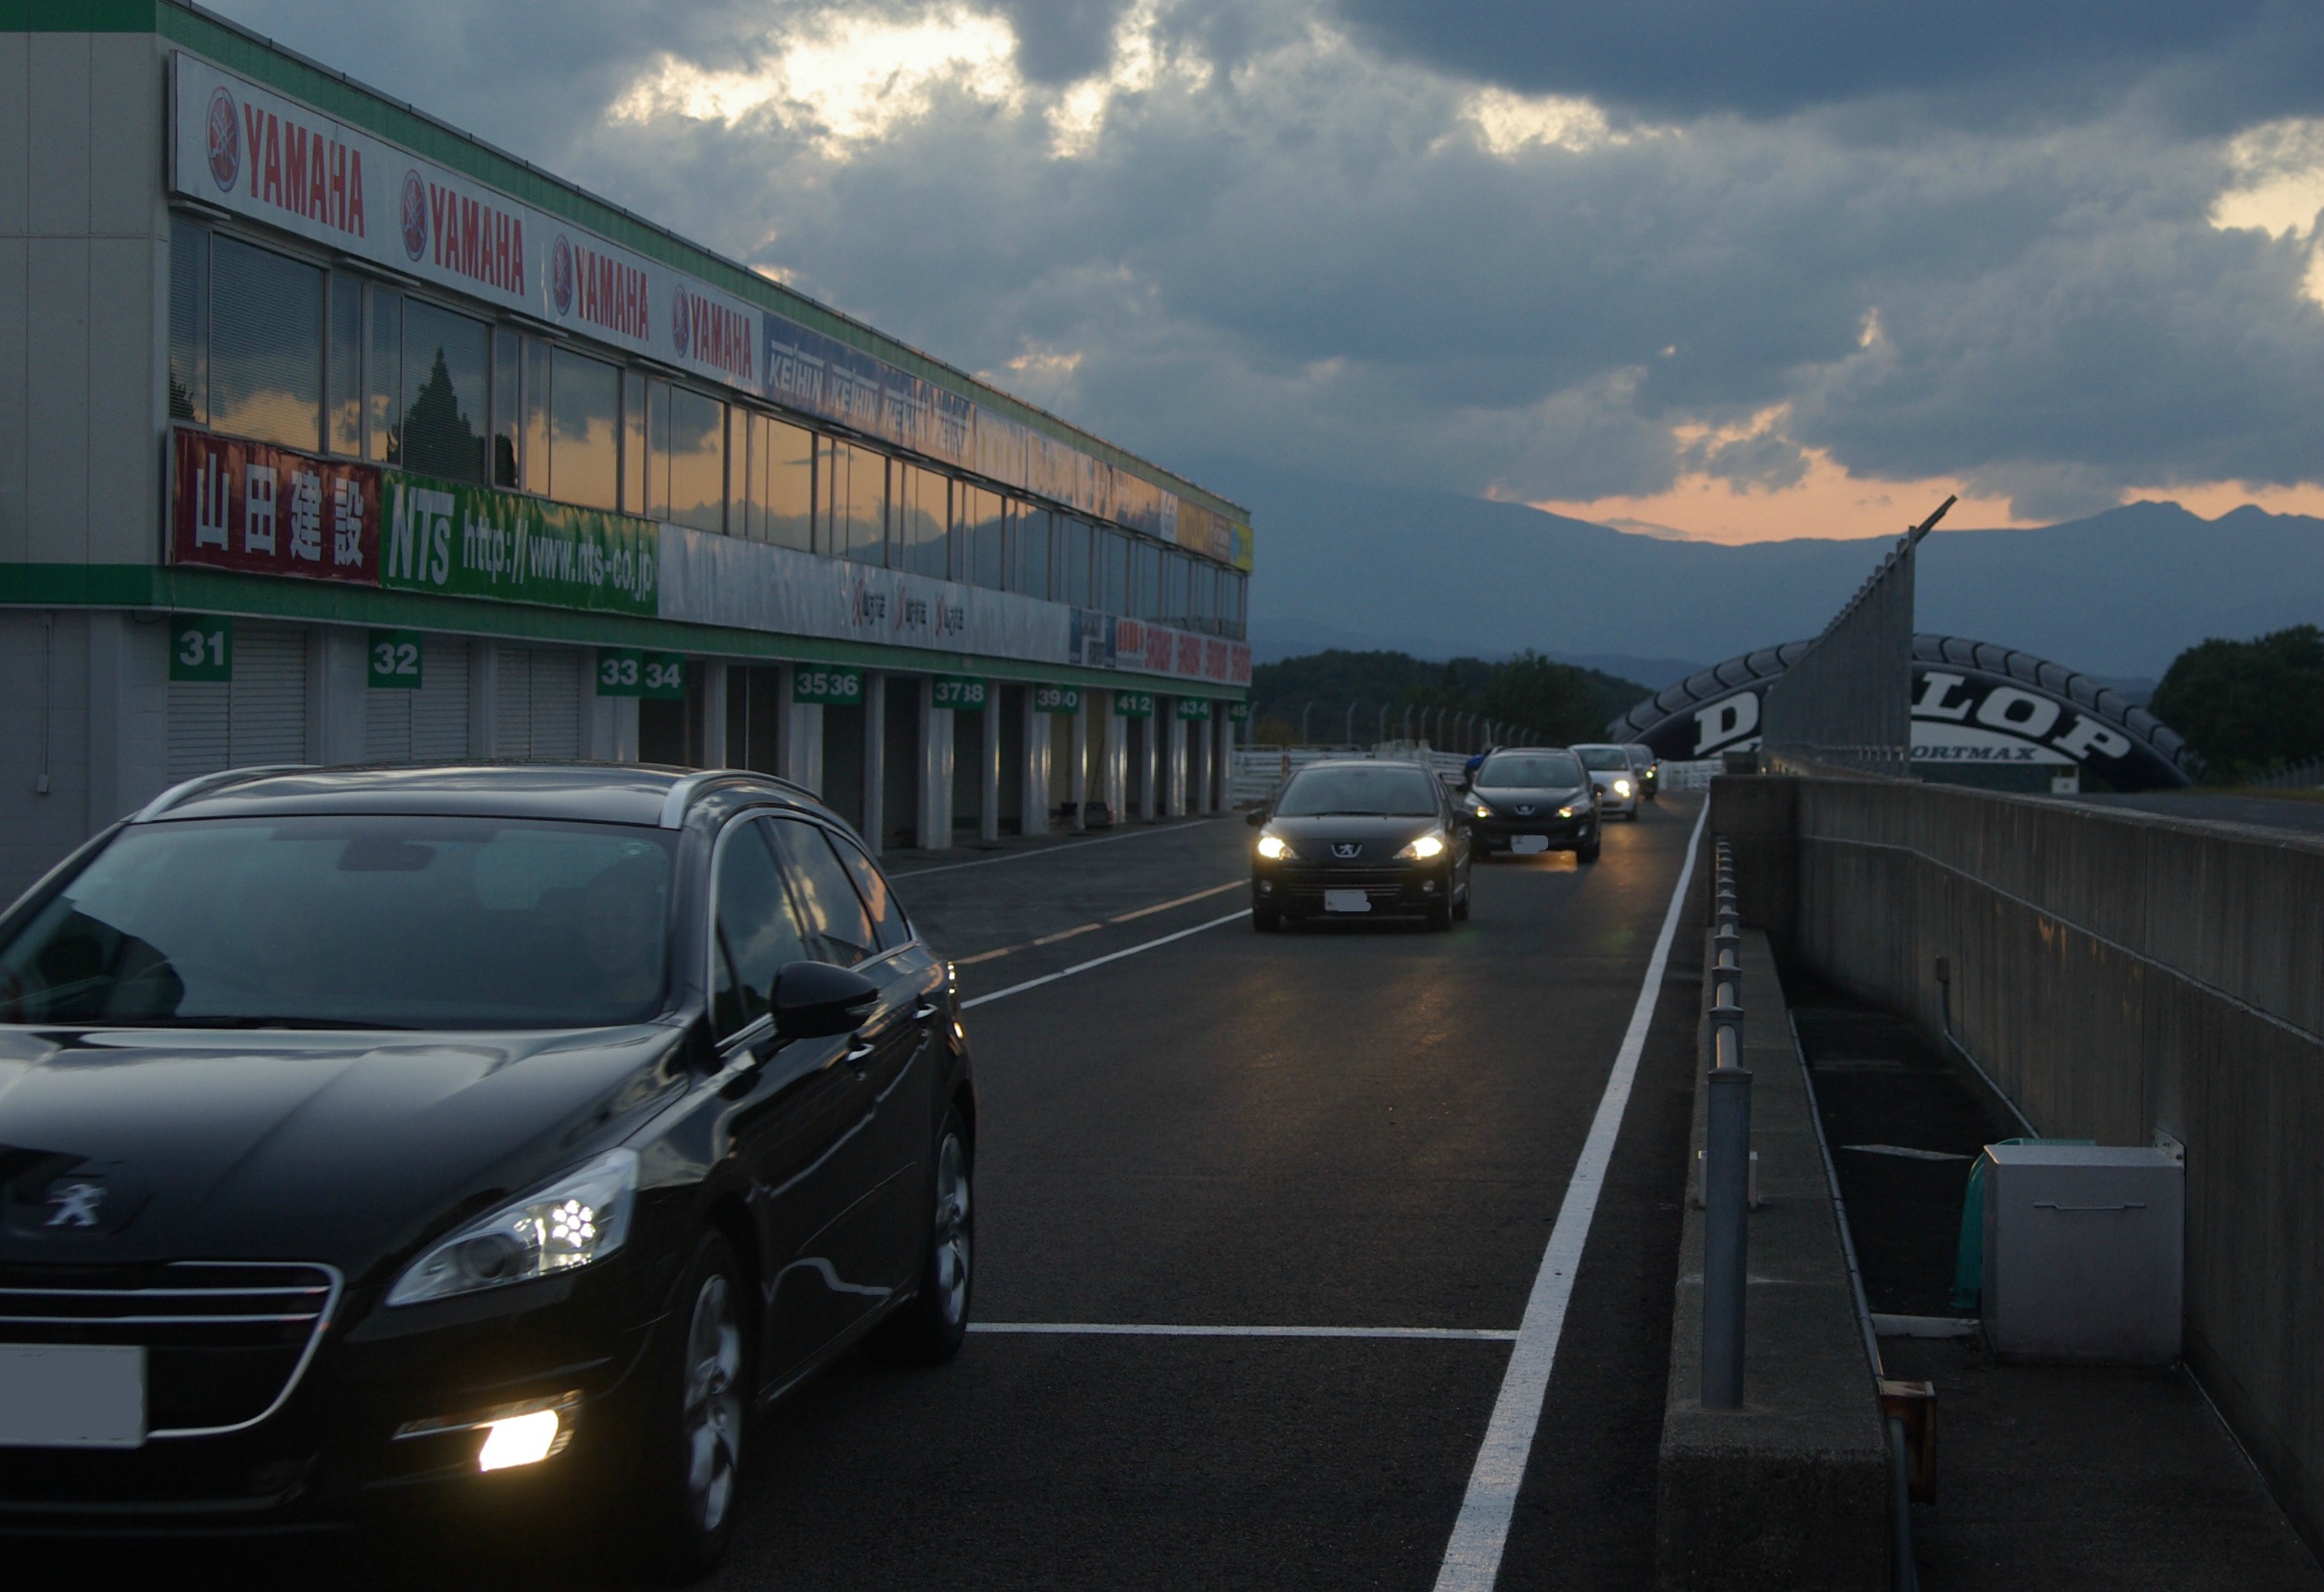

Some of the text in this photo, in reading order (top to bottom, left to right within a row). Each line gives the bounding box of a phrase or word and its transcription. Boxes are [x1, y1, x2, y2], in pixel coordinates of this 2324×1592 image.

[243, 102, 364, 238] YAMAHA
[430, 183, 525, 297] YAMAHA
[575, 244, 649, 341] YAMAHA
[690, 293, 752, 380] YAMAHA
[769, 342, 825, 404] KEIHIN
[194, 452, 364, 568] 山田建設
[179, 630, 225, 667] 31
[373, 642, 418, 675] 32
[601, 659, 638, 685] 33
[645, 662, 681, 689] 34
[797, 673, 829, 694] 35
[830, 675, 859, 697] 36
[936, 682, 962, 702] 37
[1037, 688, 1061, 707] 39
